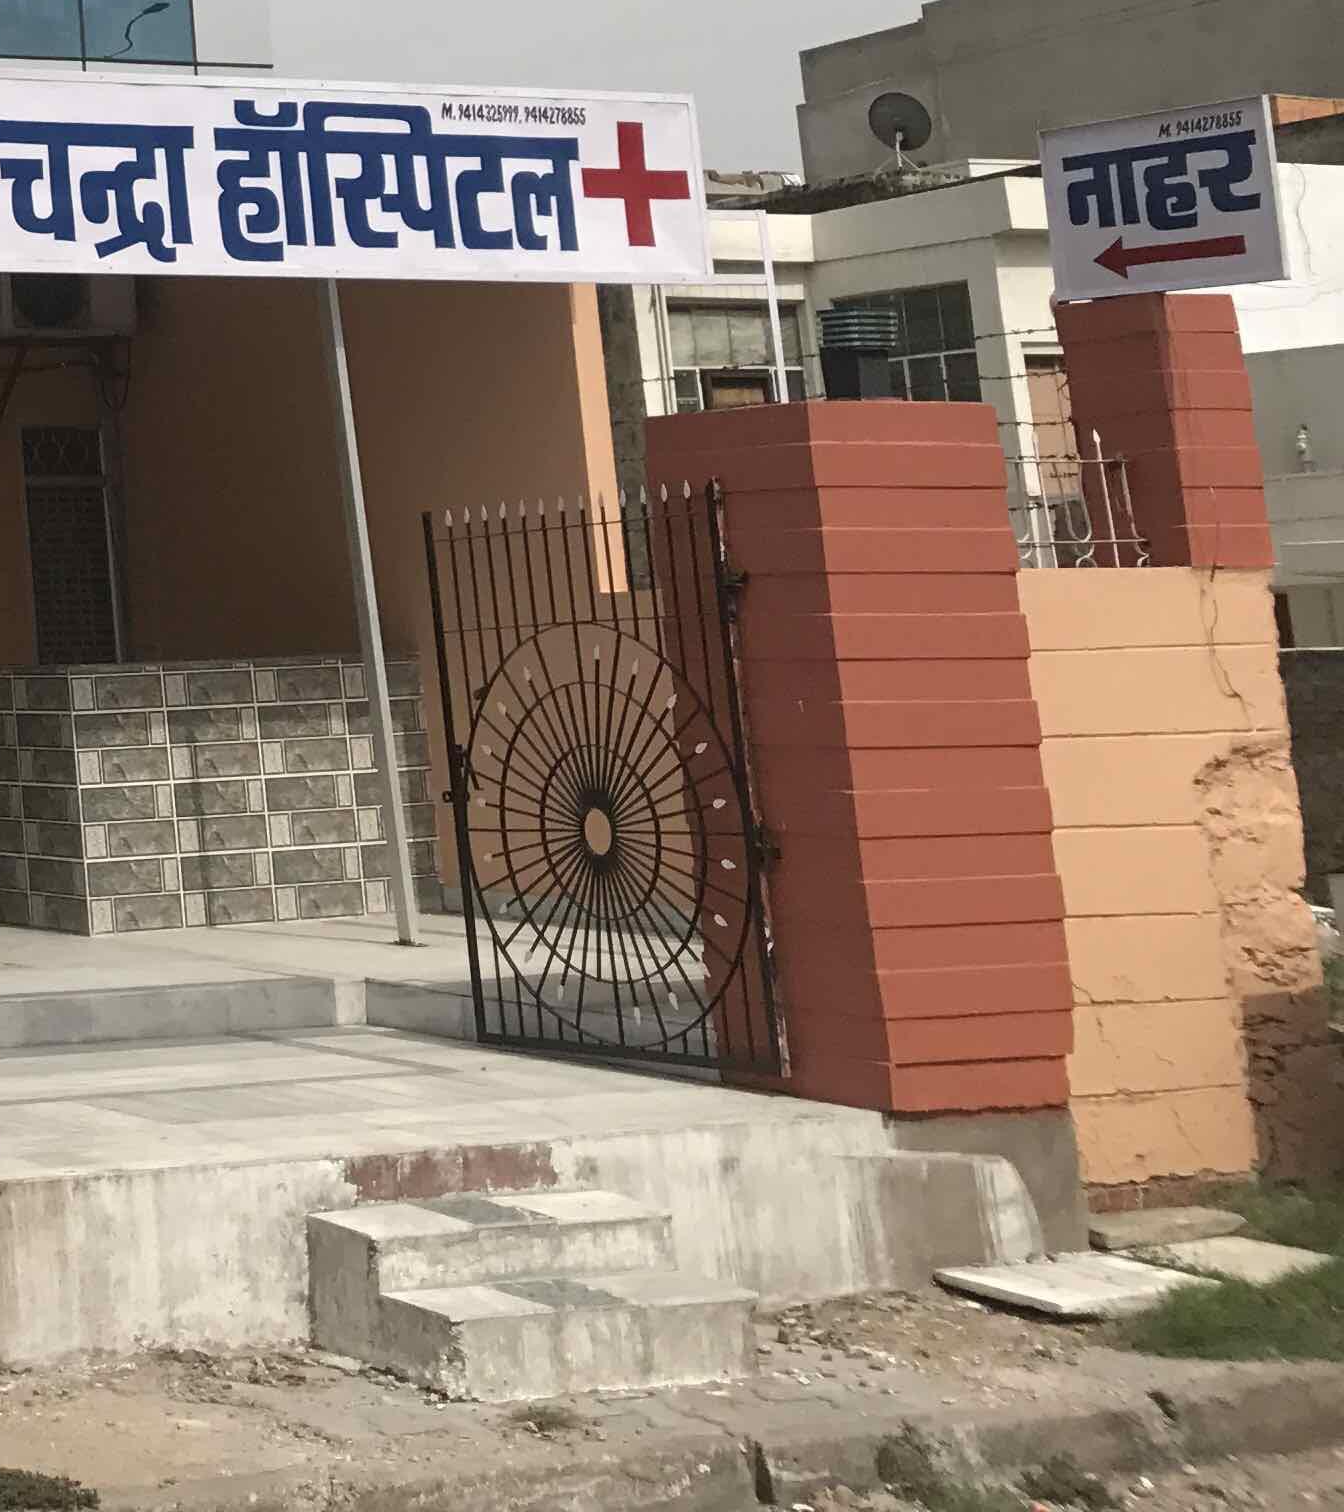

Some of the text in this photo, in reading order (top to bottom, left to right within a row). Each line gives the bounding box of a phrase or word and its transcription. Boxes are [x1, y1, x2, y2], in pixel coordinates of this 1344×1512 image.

[524, 105, 587, 125] 9414278855
[1175, 110, 1243, 135] 9414278855
[213, 100, 579, 262] हॉस्पिटल
[1061, 129, 1261, 231] नाहर
